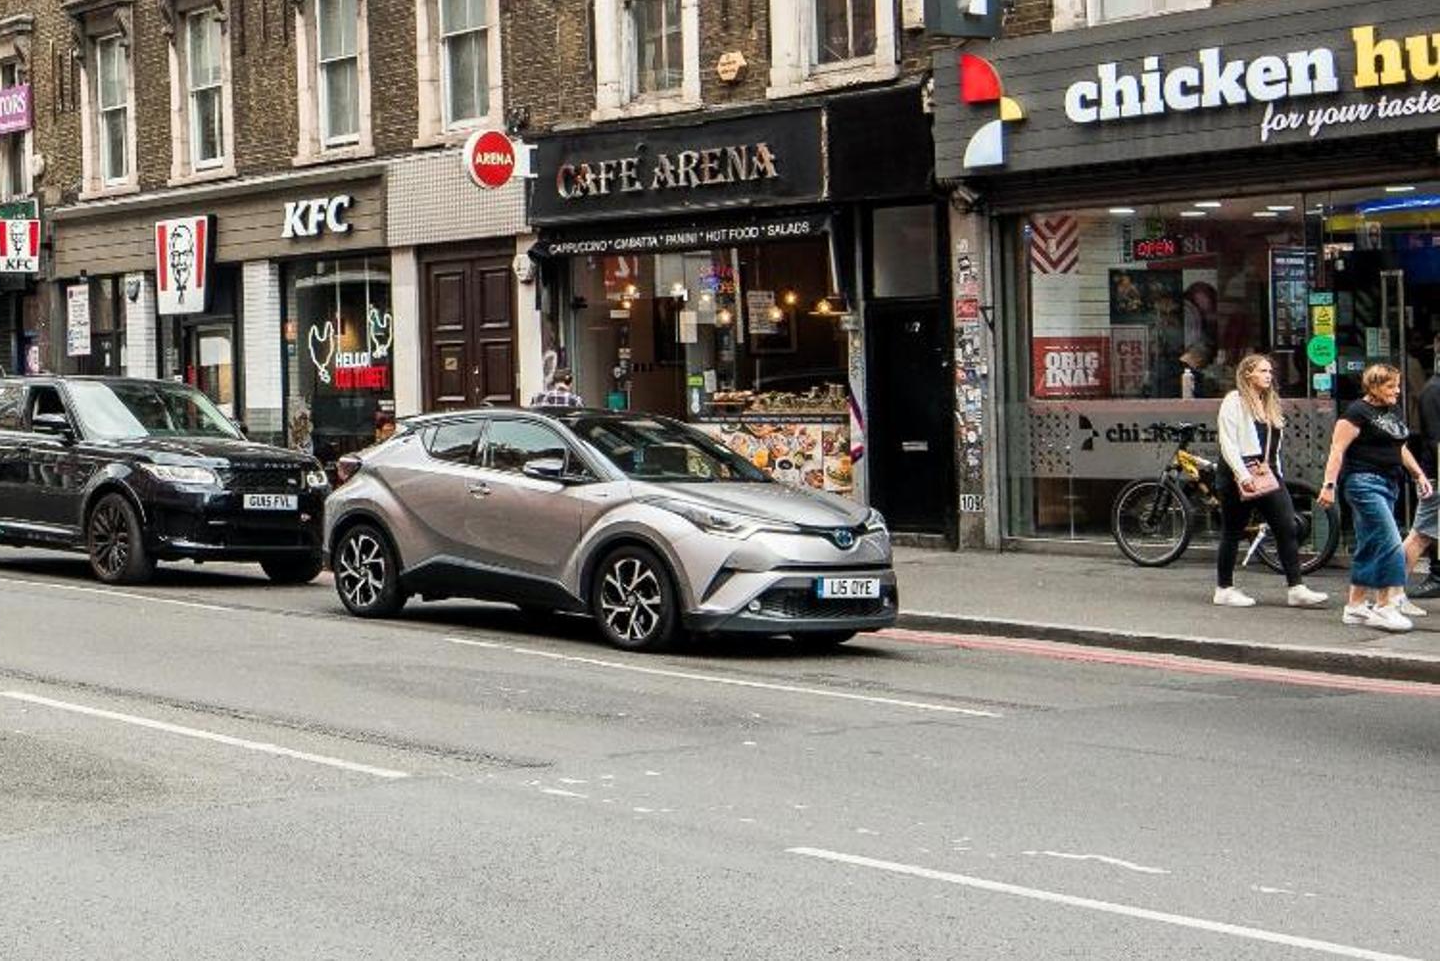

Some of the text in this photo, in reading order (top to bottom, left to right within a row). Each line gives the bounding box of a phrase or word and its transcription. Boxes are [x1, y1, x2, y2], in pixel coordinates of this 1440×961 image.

[1065, 47, 1338, 123] chicken
[1261, 102, 1304, 142] for
[1307, 103, 1374, 136] your
[475, 151, 513, 166] ARENA
[651, 142, 778, 189] ARENA
[280, 194, 350, 238] KFC
[548, 240, 607, 255] CAPPUCCINO
[665, 232, 698, 245] PANINI
[705, 229, 728, 242] HOT
[729, 226, 759, 240] FOOD
[767, 221, 810, 236] SALADS
[1137, 240, 1174, 256] OPEN
[5, 260, 33, 270] KFC
[1044, 352, 1099, 369] ORIG
